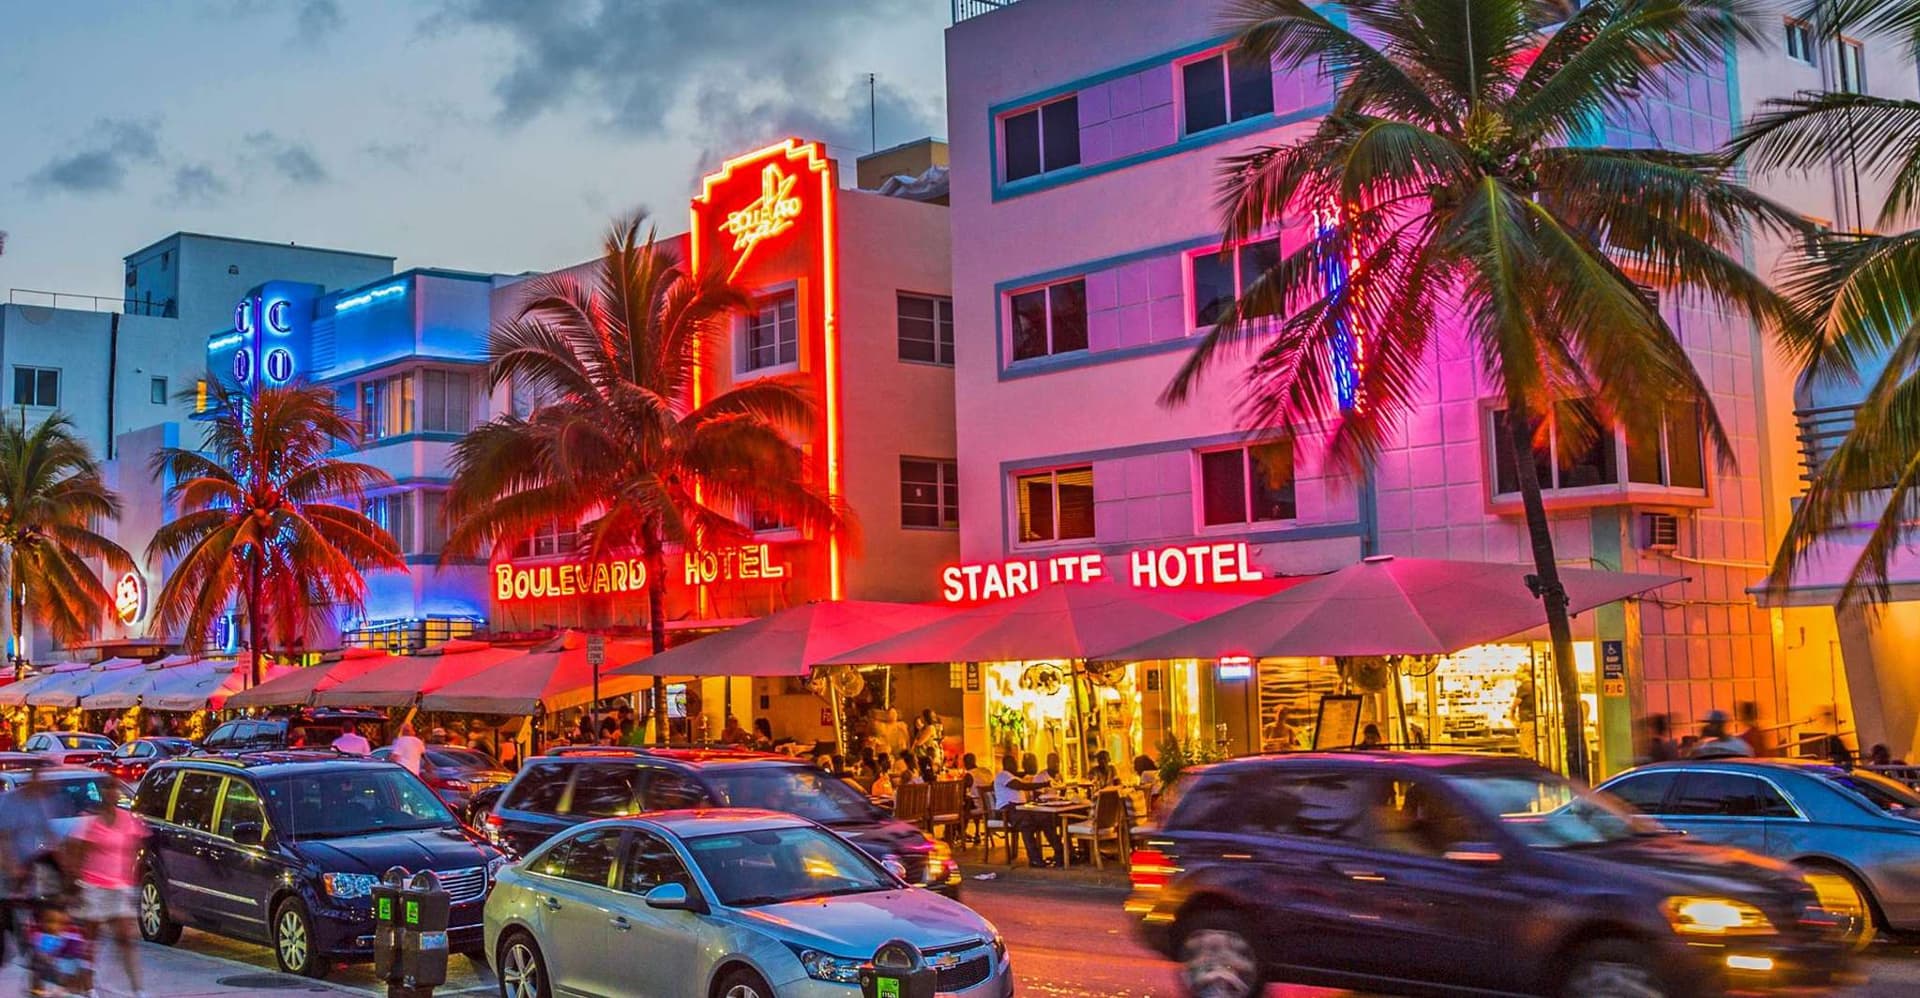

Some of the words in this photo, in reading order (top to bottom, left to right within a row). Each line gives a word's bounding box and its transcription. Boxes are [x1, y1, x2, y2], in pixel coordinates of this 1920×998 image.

[496, 559, 647, 600] BOULEVARD
[685, 544, 783, 586] HOTEL
[1131, 542, 1263, 588] HOTEL
